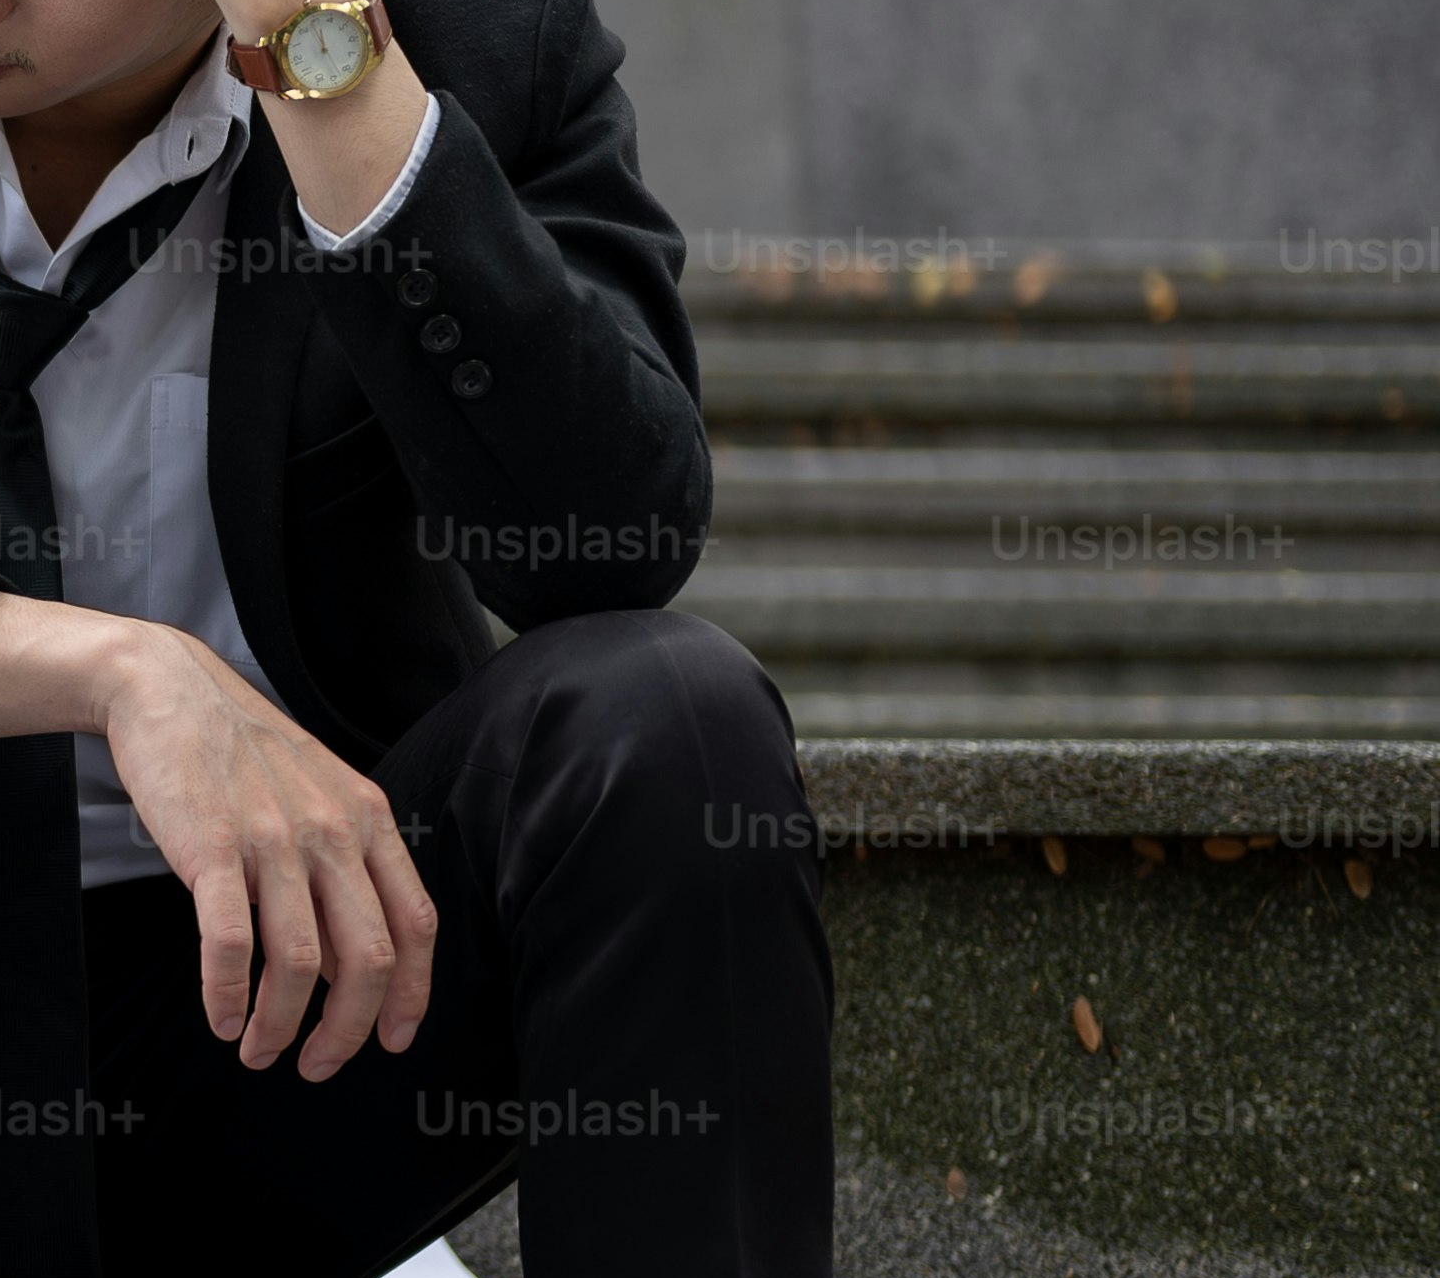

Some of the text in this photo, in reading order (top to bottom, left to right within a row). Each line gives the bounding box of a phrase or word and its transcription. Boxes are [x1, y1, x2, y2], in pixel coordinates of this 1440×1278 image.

[299, 27, 309, 35] 2
[339, 19, 350, 31] 5
[293, 54, 304, 66] 12
[300, 67, 313, 80] 11
[315, 73, 325, 83] 10
